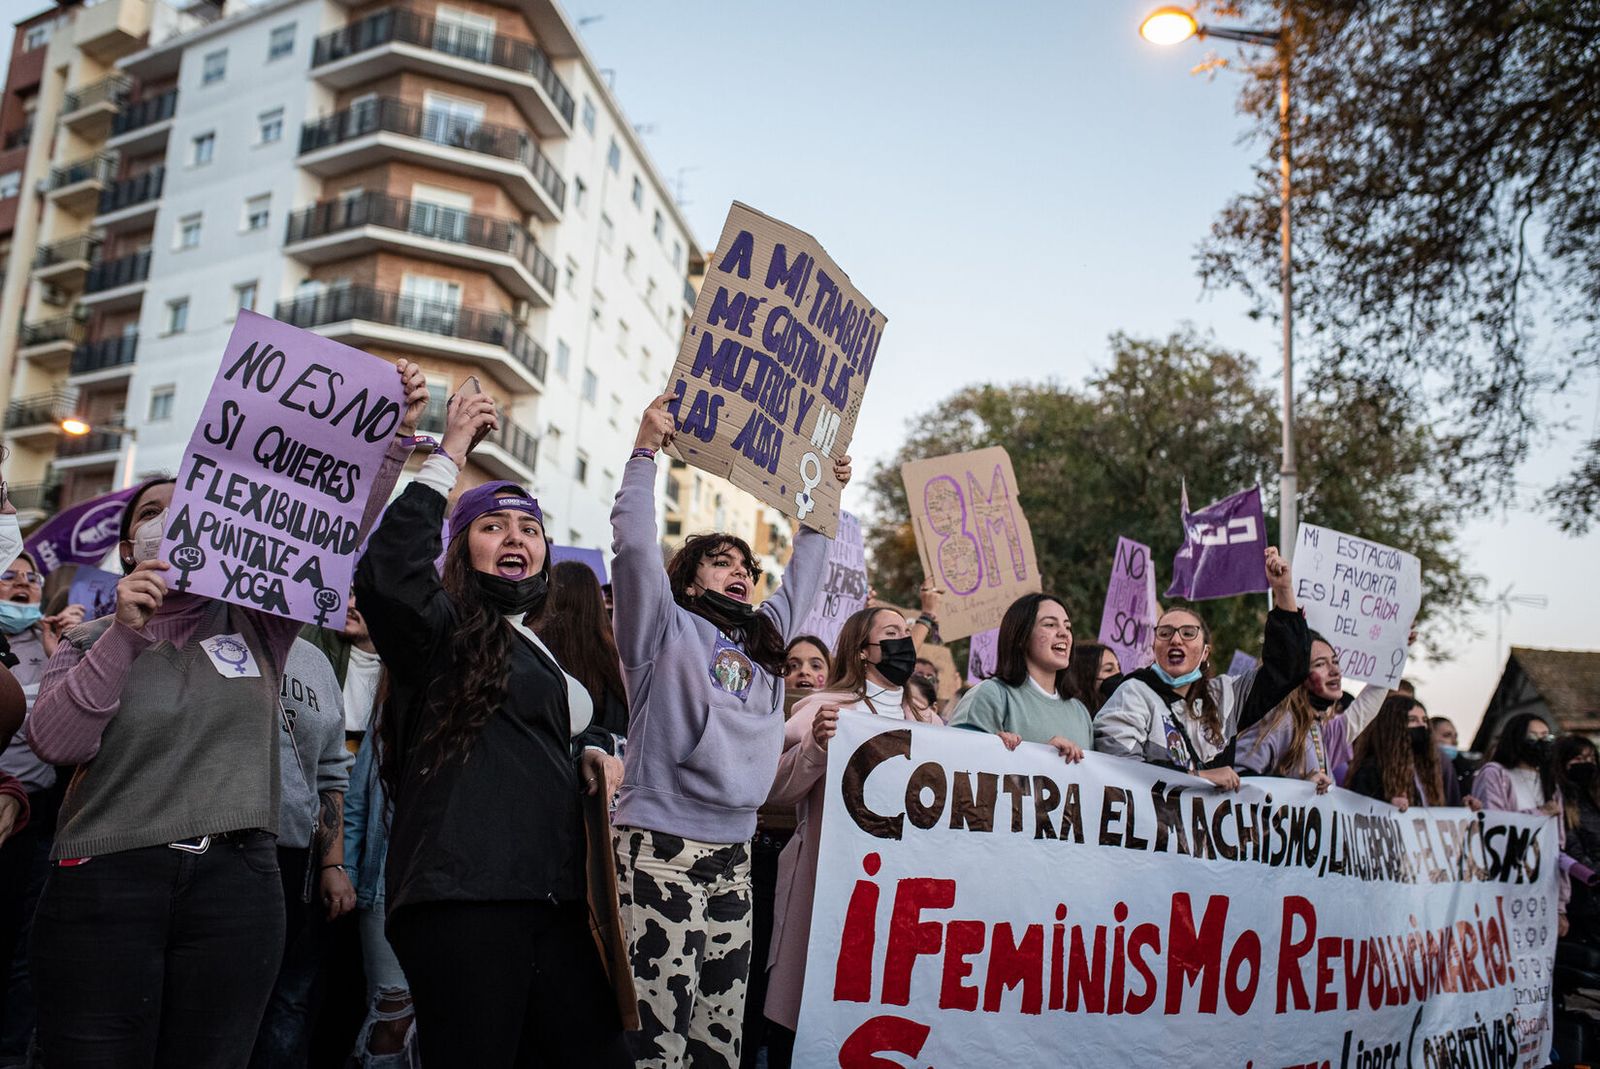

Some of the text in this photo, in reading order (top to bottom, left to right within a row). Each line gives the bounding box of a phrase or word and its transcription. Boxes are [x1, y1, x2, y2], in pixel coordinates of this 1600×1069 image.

[718, 230, 754, 280] A
[765, 243, 815, 308] MI
[707, 287, 767, 337] ME
[224, 341, 400, 443] NO ES NO
[667, 379, 725, 443] LAS
[690, 331, 841, 458] MUJERES Y NO
[204, 400, 361, 503] SI QUIERES
[185, 453, 360, 556] FLEXIBILIDAD
[924, 464, 1027, 595] 8M
[167, 504, 300, 576] APÚNTATE
[291, 556, 324, 589] A
[1116, 542, 1145, 579] NO
[1337, 536, 1402, 571] ESTACIÓN
[221, 561, 290, 615] YOGA
[1297, 579, 1325, 600] ES
[1330, 585, 1350, 610] LA
[1333, 563, 1396, 595] FAVORITA
[1334, 616, 1358, 637] DEL
[280, 673, 320, 712] IOR
[842, 729, 1084, 844] CONTRA
[1098, 786, 1149, 851] EL
